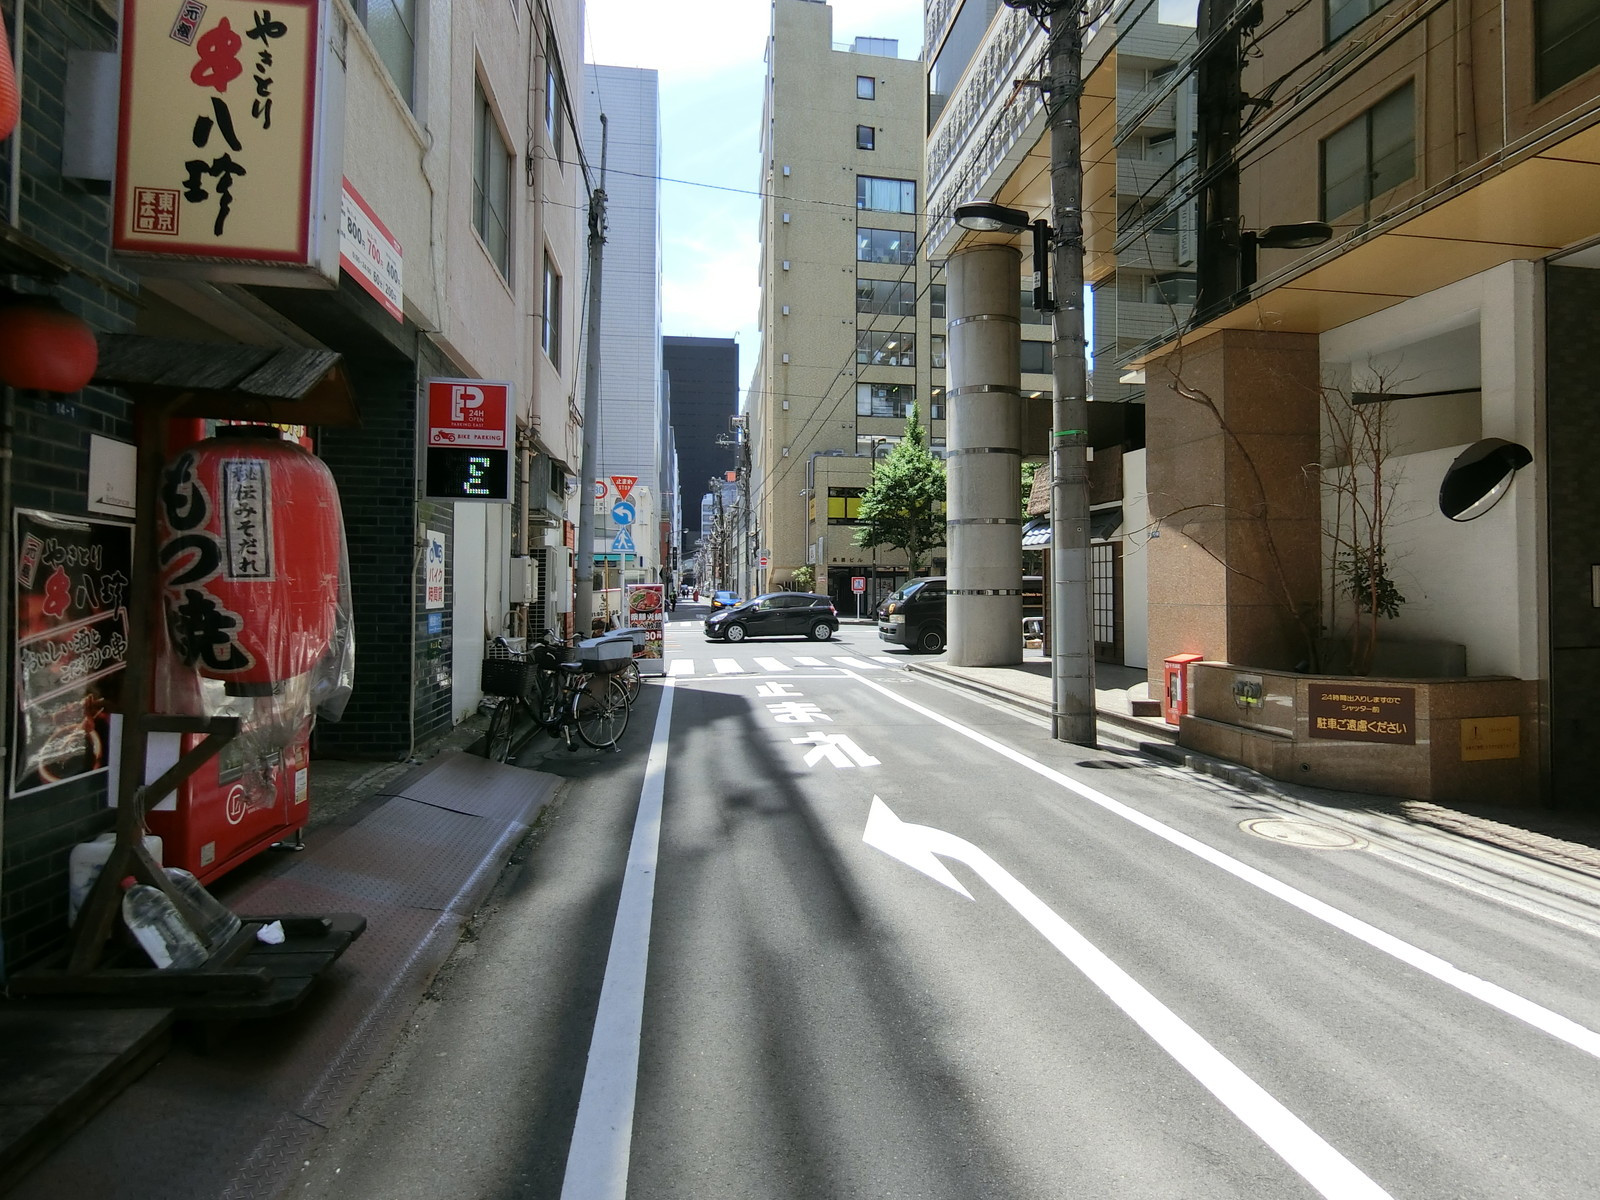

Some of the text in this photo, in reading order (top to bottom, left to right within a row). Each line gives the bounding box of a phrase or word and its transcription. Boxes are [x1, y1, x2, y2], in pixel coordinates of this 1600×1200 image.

[246, 10, 288, 130] やきとり
[182, 16, 246, 237] 串八珍
[157, 192, 174, 231] 東京
[232, 464, 260, 573] 秘伝みそだれ
[42, 538, 102, 571] やきとり
[428, 567, 443, 583] バイク
[1321, 694, 1401, 704] 24時間出入りしますので
[1341, 705, 1380, 713] シャッター前
[755, 682, 882, 768] 止まれ
[1316, 717, 1407, 734] 駐車ご遠慮ください
